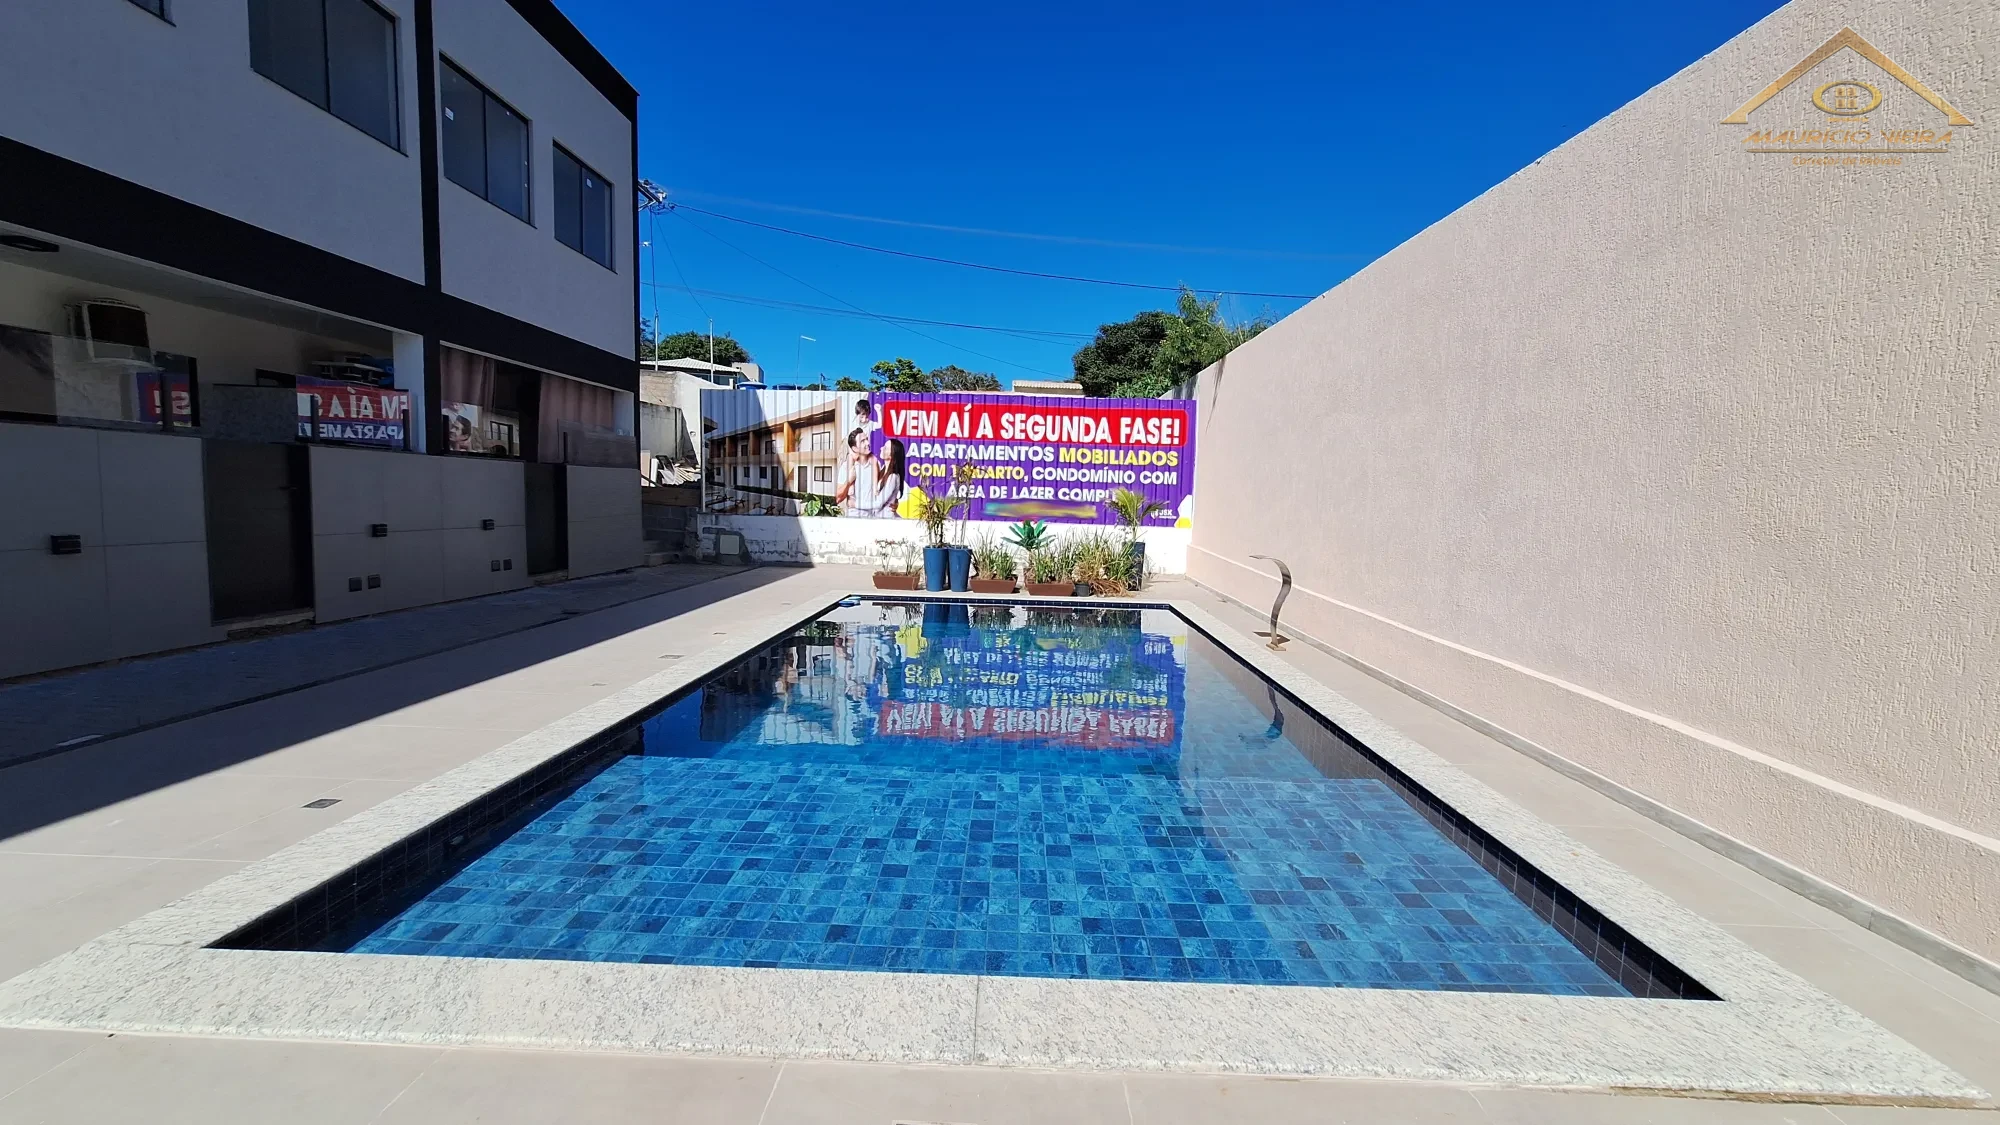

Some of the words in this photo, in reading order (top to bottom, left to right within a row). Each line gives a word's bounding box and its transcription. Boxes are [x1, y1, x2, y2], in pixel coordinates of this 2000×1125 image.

[890, 409, 938, 437] VEM
[945, 403, 972, 438] AÍ
[976, 412, 993, 439] A
[1001, 412, 1112, 443] SEGUNDA
[1120, 417, 1180, 445] FASE!
[906, 442, 1054, 463] APARTAMENTOS
[1059, 447, 1179, 466] MOBILIADOS
[909, 463, 946, 477] COM
[1032, 466, 1136, 484] CONDOMÍNIO
[1140, 471, 1177, 485] COM
[990, 486, 1007, 499] DE
[1013, 487, 1054, 500] LAZER
